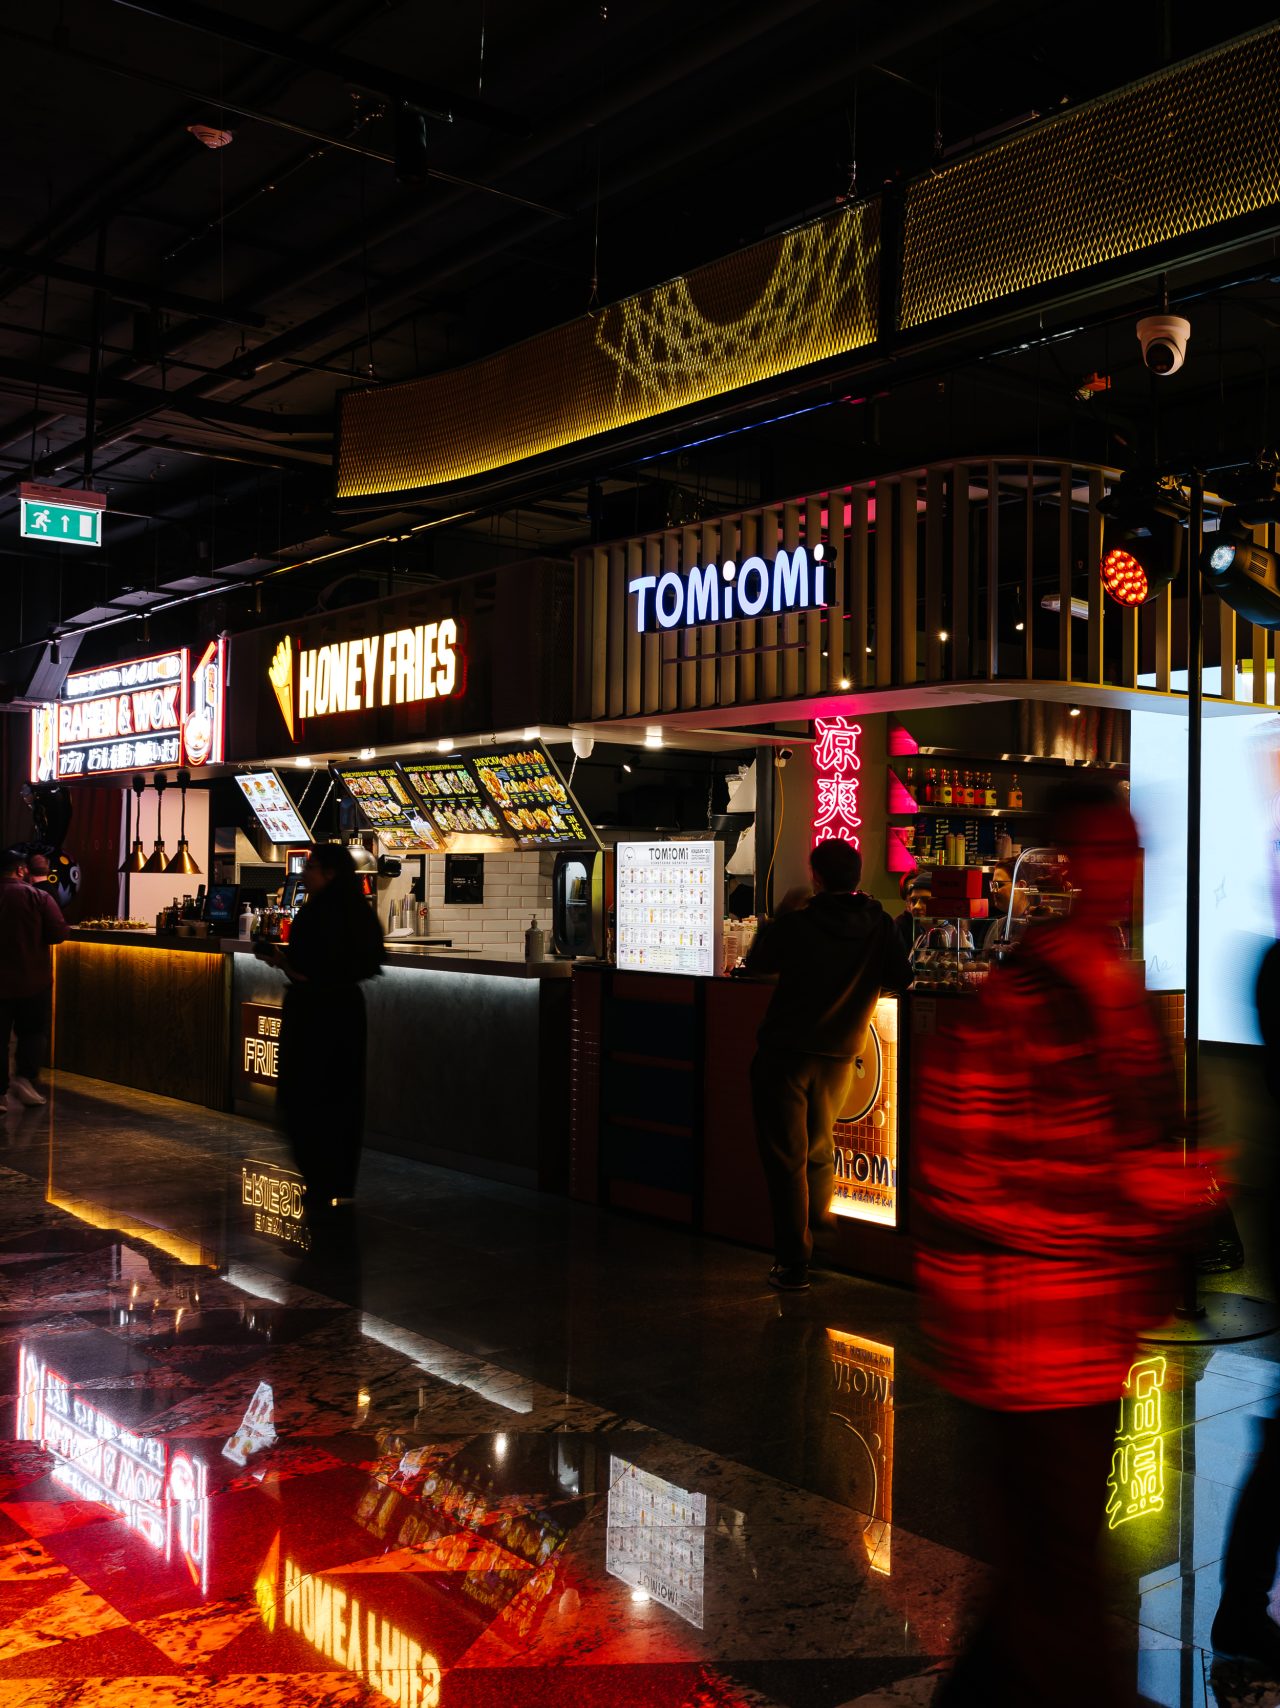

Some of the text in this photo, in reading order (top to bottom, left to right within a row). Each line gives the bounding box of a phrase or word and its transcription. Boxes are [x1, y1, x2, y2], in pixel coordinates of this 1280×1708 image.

[629, 543, 825, 633] TOMiOMi
[299, 618, 458, 718] HONEY FRIES
[59, 697, 117, 743] RAMEN
[118, 695, 134, 735] &
[132, 686, 181, 732] WOK
[814, 715, 861, 850] 凉爽
[648, 847, 689, 860] TOMiOMi
[244, 1037, 280, 1078] FRIE
[832, 1147, 897, 1188] MiOMi
